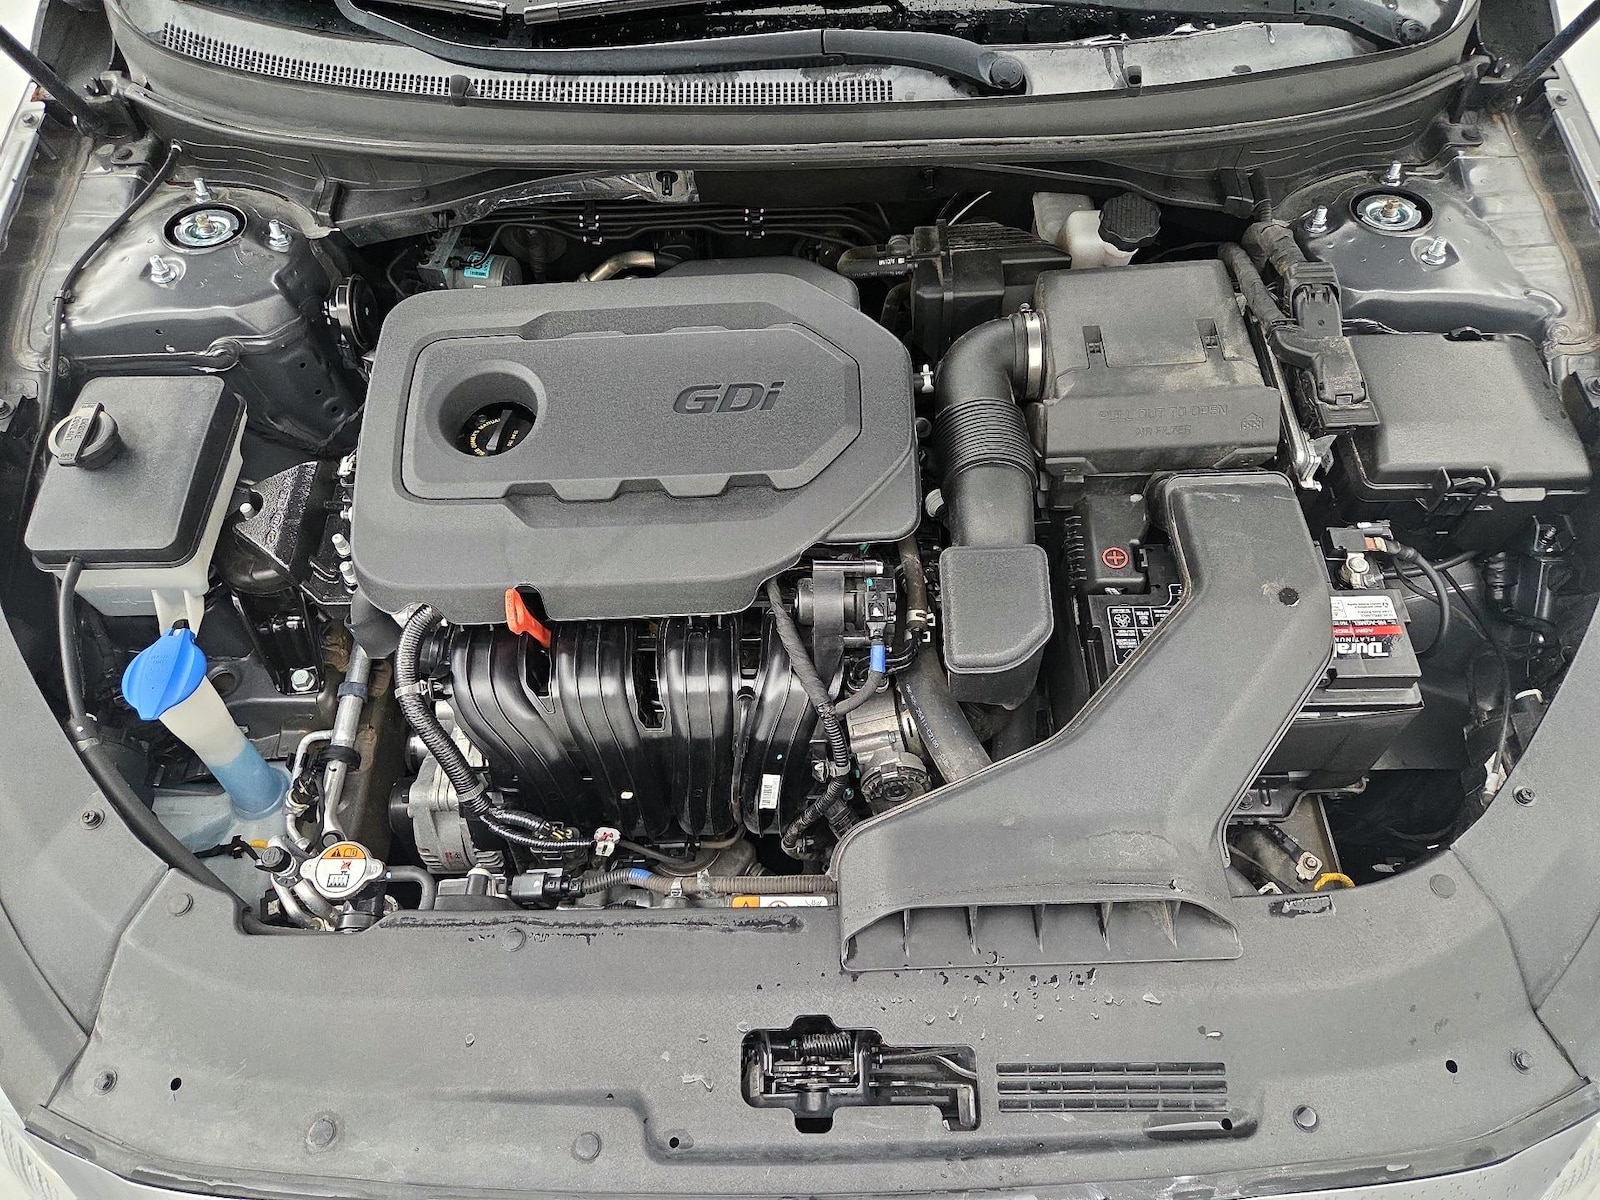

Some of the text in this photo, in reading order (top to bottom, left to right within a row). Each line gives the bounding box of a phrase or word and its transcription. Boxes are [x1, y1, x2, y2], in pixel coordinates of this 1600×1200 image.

[673, 380, 785, 414] GDi
[1099, 404, 1228, 422] PULL OUT TO OPEN
[1135, 424, 1191, 438] AIR FILTER
